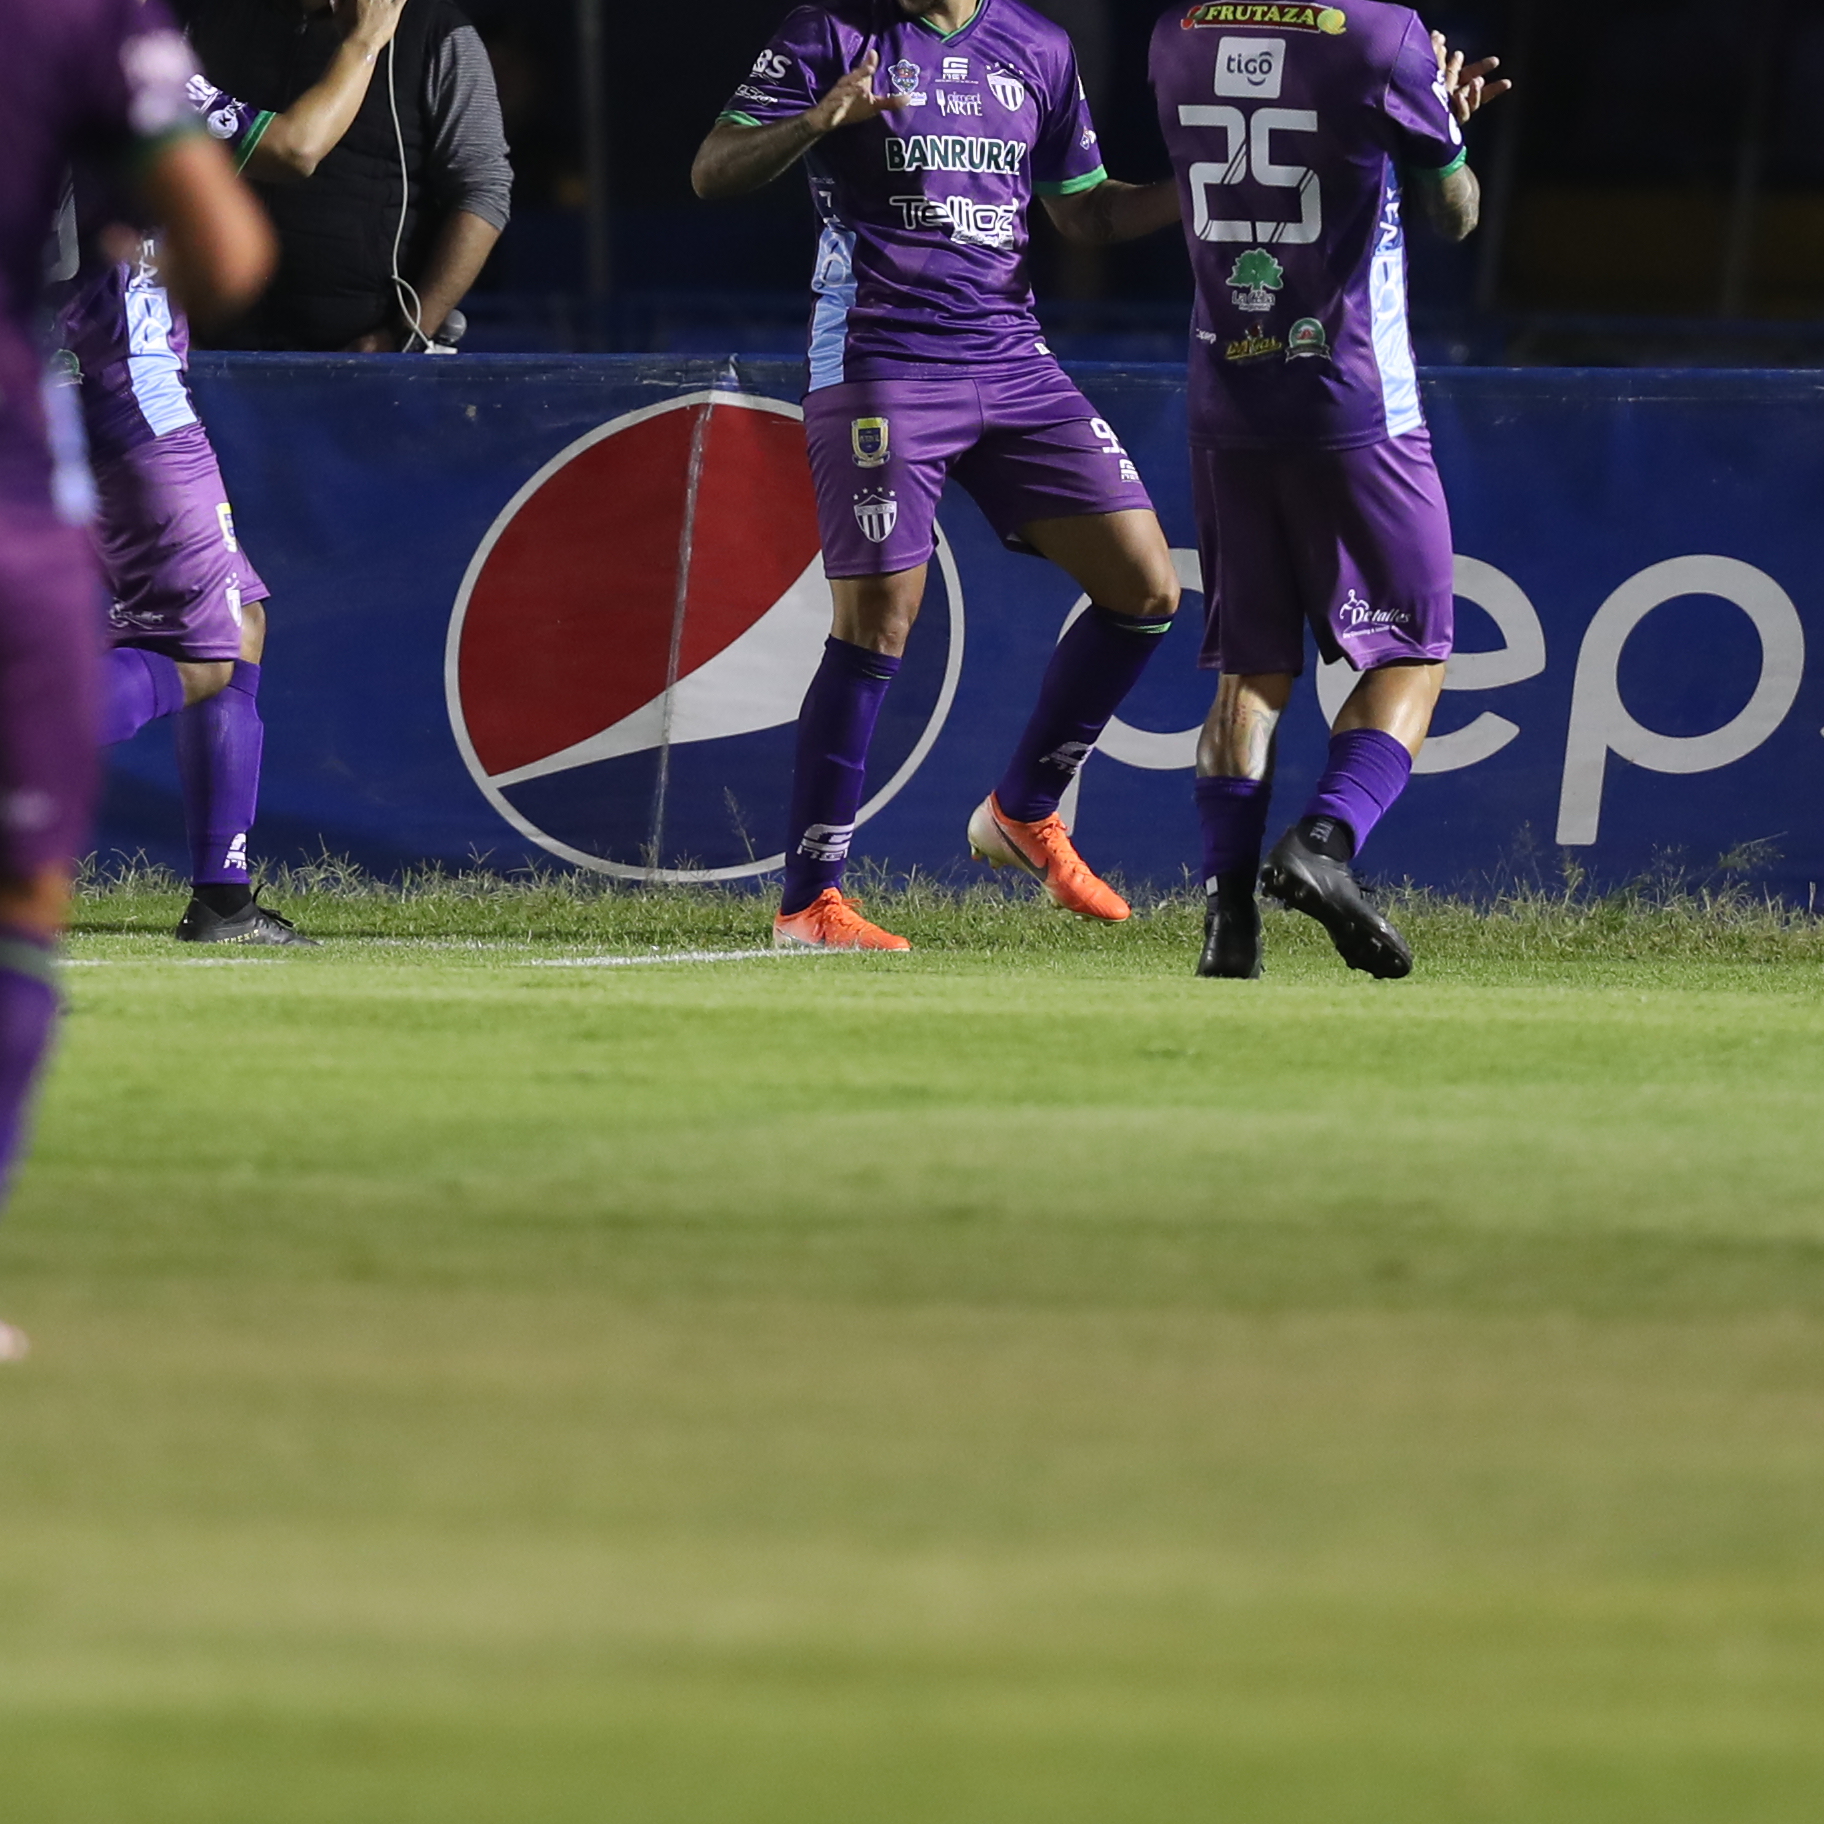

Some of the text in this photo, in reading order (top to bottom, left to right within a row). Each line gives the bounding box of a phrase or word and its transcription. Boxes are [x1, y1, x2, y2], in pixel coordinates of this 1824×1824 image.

[1204, 4, 1316, 26] FRUTAZA
[1177, 104, 1322, 244] 25
[1351, 606, 1412, 626] Detalles
